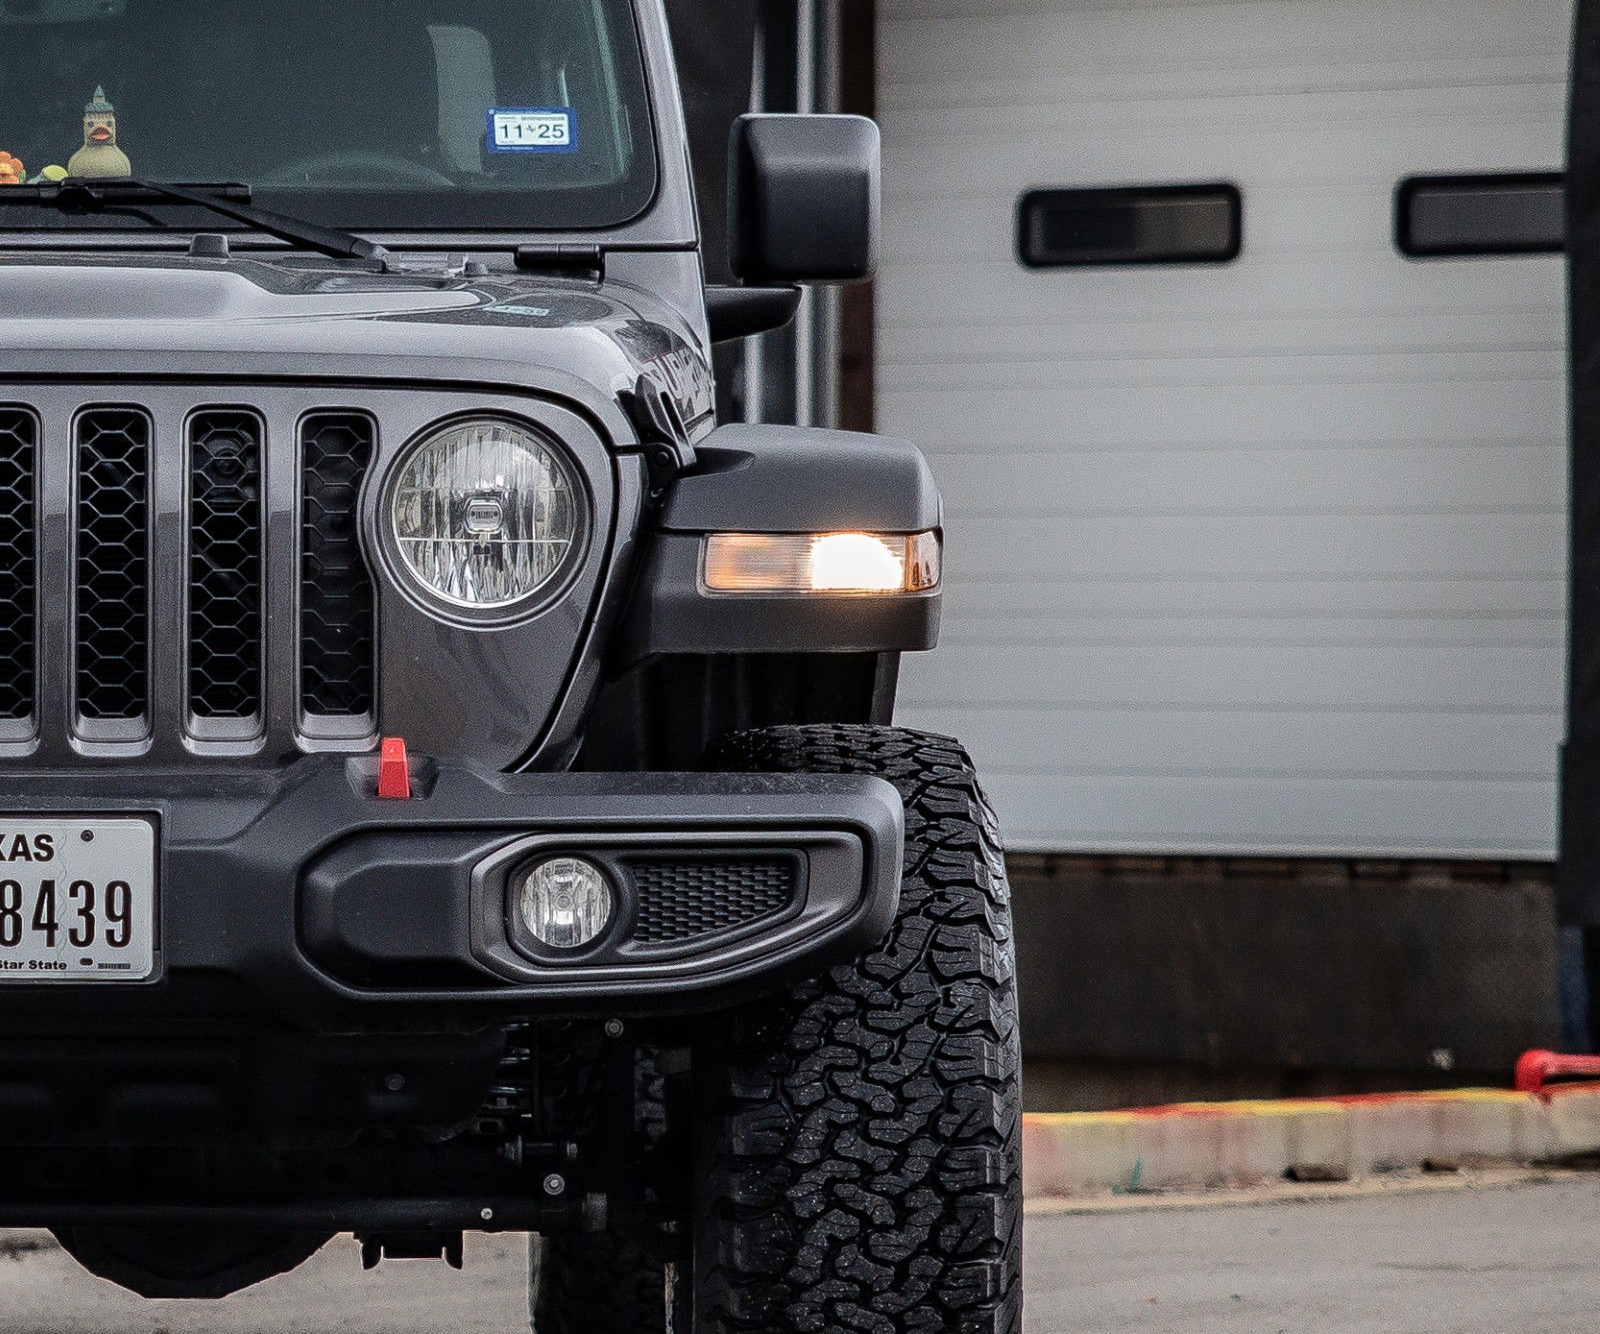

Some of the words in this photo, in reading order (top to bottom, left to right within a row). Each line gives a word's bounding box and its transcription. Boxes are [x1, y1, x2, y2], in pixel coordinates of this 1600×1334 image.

[499, 124, 523, 139] 11
[538, 124, 564, 139] 25
[28, 959, 68, 971] State
